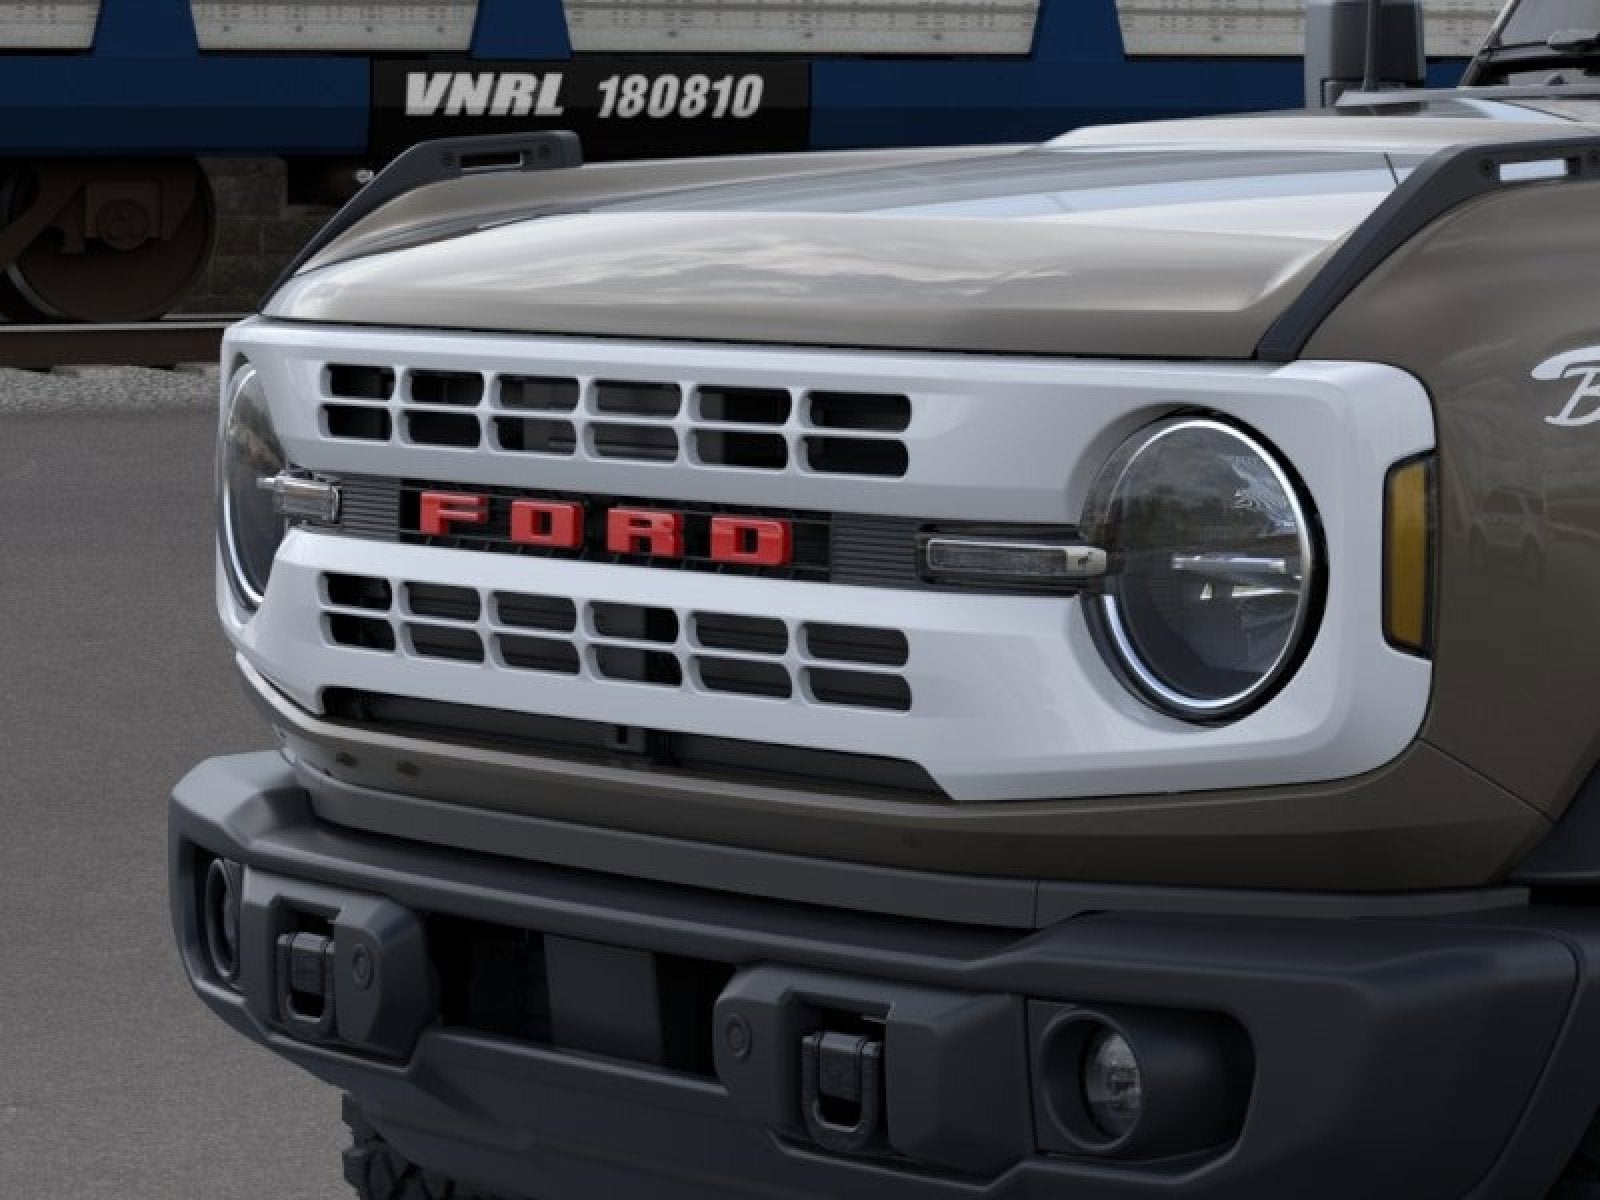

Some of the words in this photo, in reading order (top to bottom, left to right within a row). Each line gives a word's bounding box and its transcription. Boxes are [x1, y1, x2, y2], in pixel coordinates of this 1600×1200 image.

[405, 72, 563, 116] VNRL
[598, 74, 764, 119] 180810
[420, 490, 792, 567] FORD
